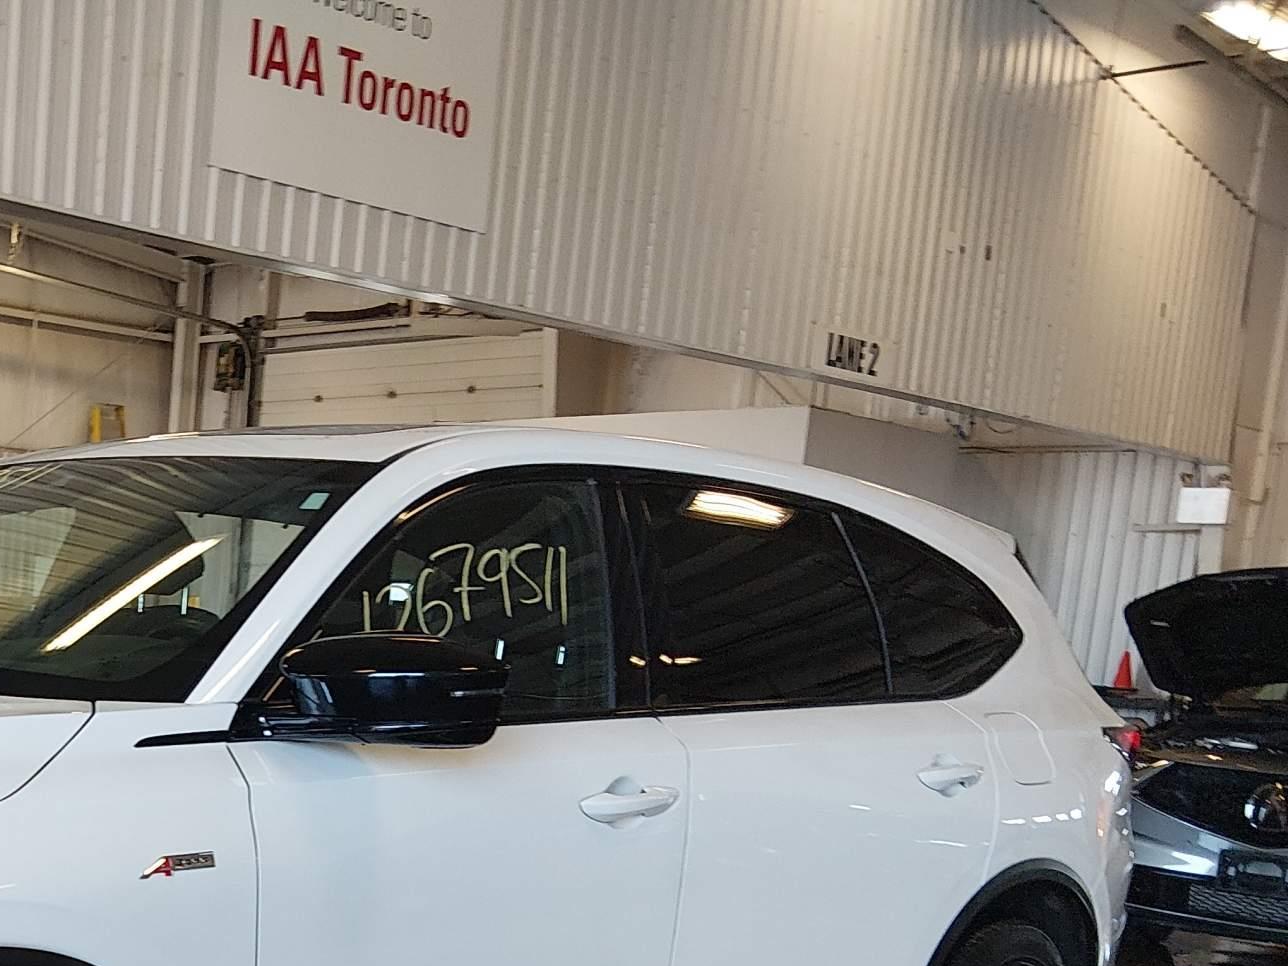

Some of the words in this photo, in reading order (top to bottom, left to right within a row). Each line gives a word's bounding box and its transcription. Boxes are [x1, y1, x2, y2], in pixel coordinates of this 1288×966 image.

[312, 0, 407, 32] come
[411, 8, 433, 40] to
[248, 18, 325, 96] IAA
[336, 45, 470, 138] Toronto
[826, 332, 867, 373] LANE
[868, 342, 880, 377] 2
[363, 543, 568, 638] 12679511
